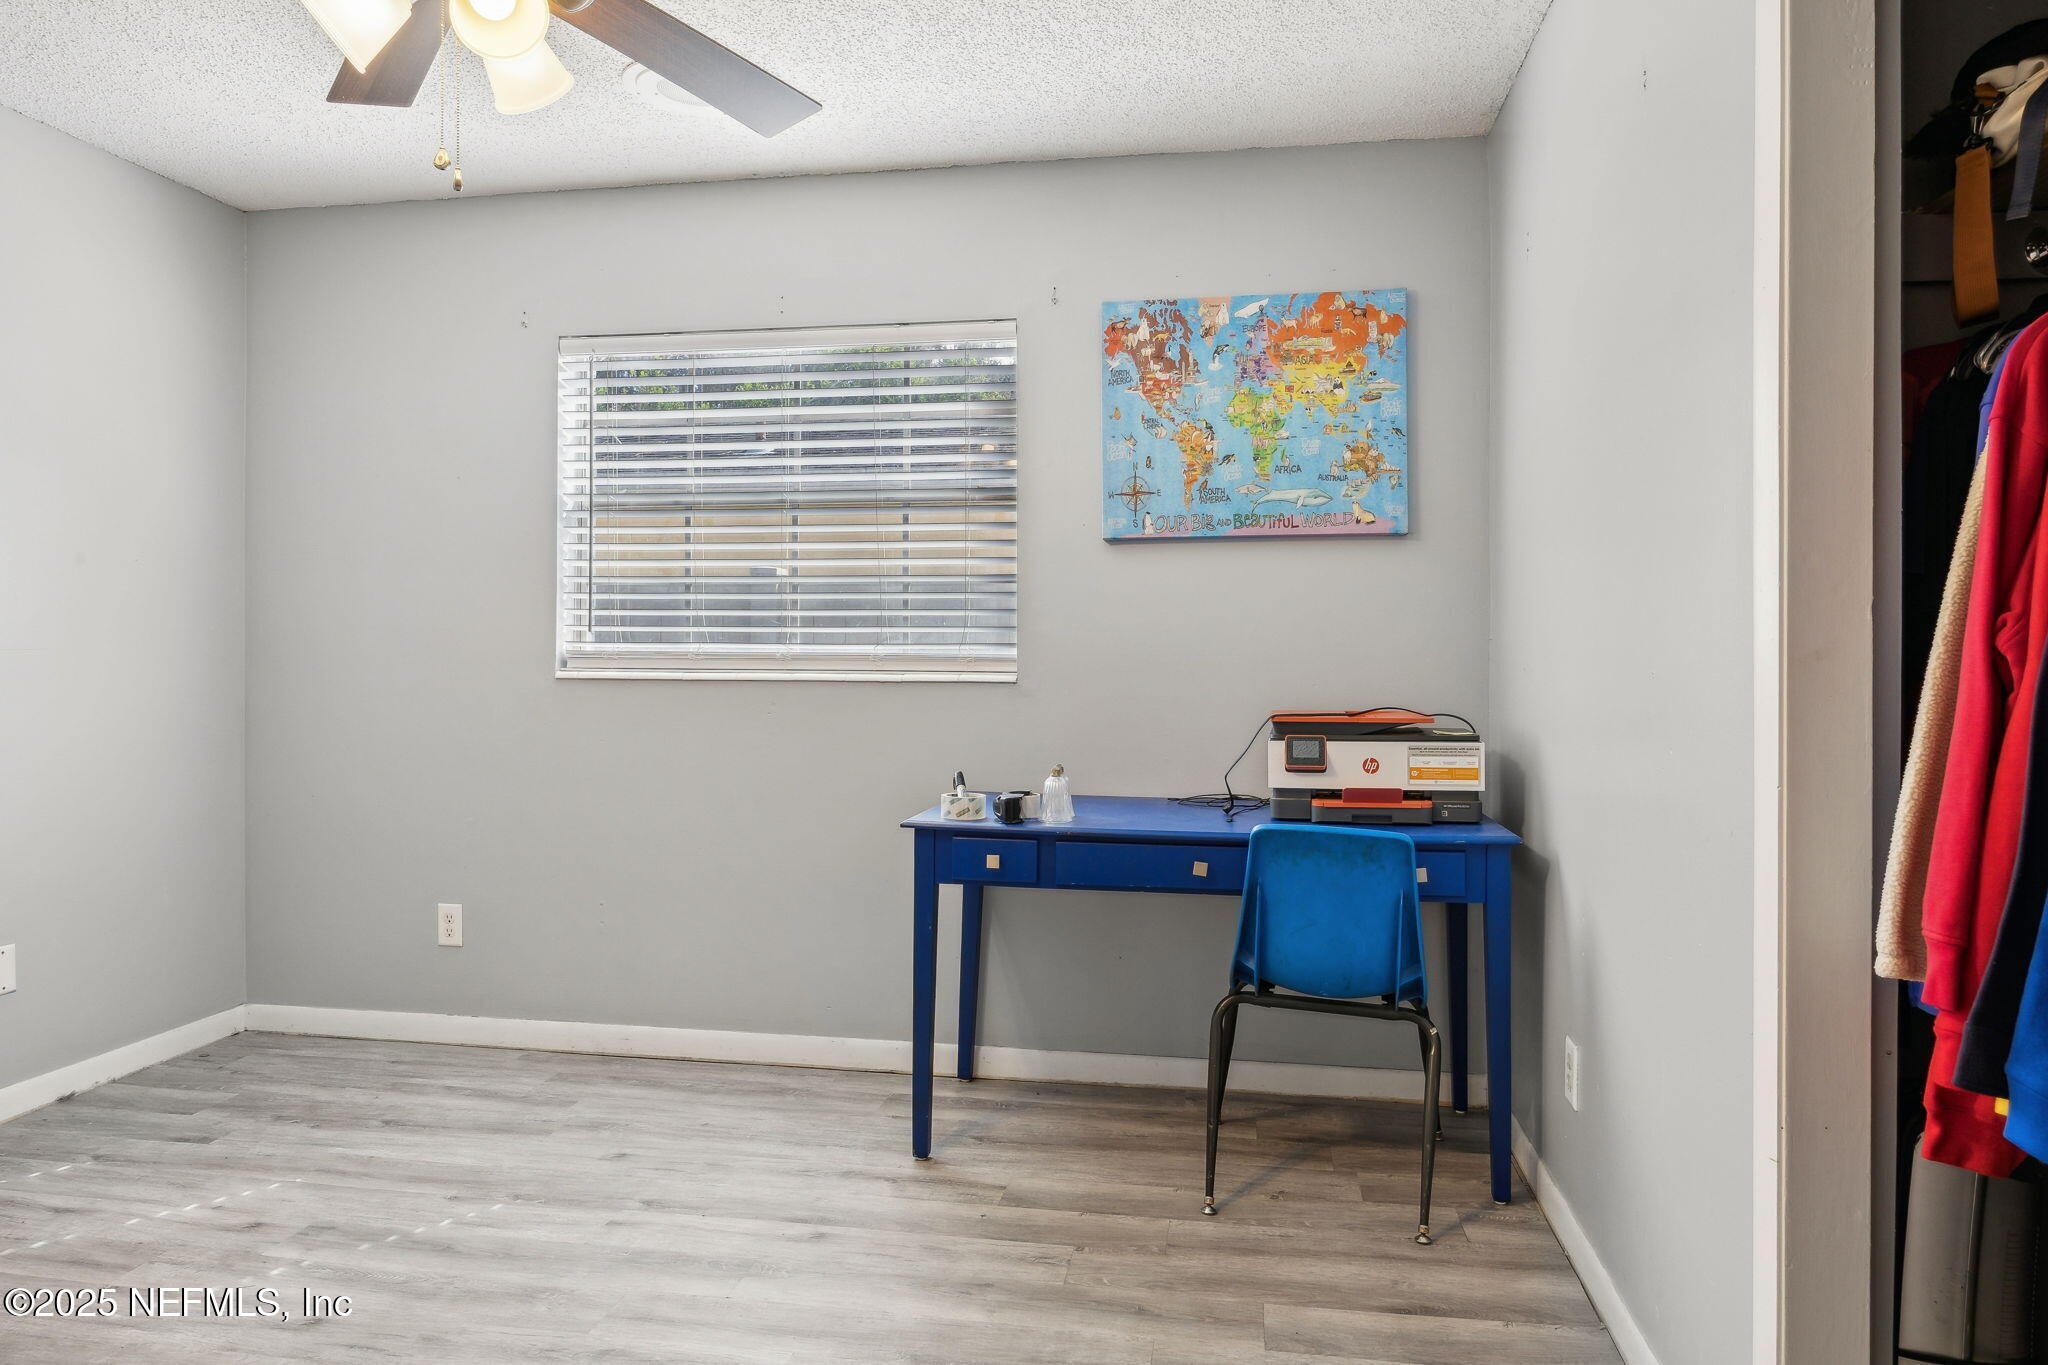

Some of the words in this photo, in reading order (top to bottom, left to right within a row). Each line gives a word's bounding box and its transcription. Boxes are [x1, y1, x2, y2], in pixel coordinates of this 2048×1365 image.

[1242, 324, 1266, 333] EUROPE
[1110, 369, 1131, 379] NORTH
[1108, 376, 1134, 387] AMERICA
[1132, 461, 1139, 472] N
[1273, 464, 1303, 475] AFRICA
[1317, 473, 1349, 482] AUSTRALIA
[1156, 489, 1162, 497] E
[1203, 487, 1226, 497] SOUTH
[1199, 494, 1232, 505] AMERICA
[1132, 519, 1139, 528] S
[1154, 514, 1188, 534] OUR
[1299, 511, 1355, 528] WORLD
[1363, 757, 1379, 774] hp
